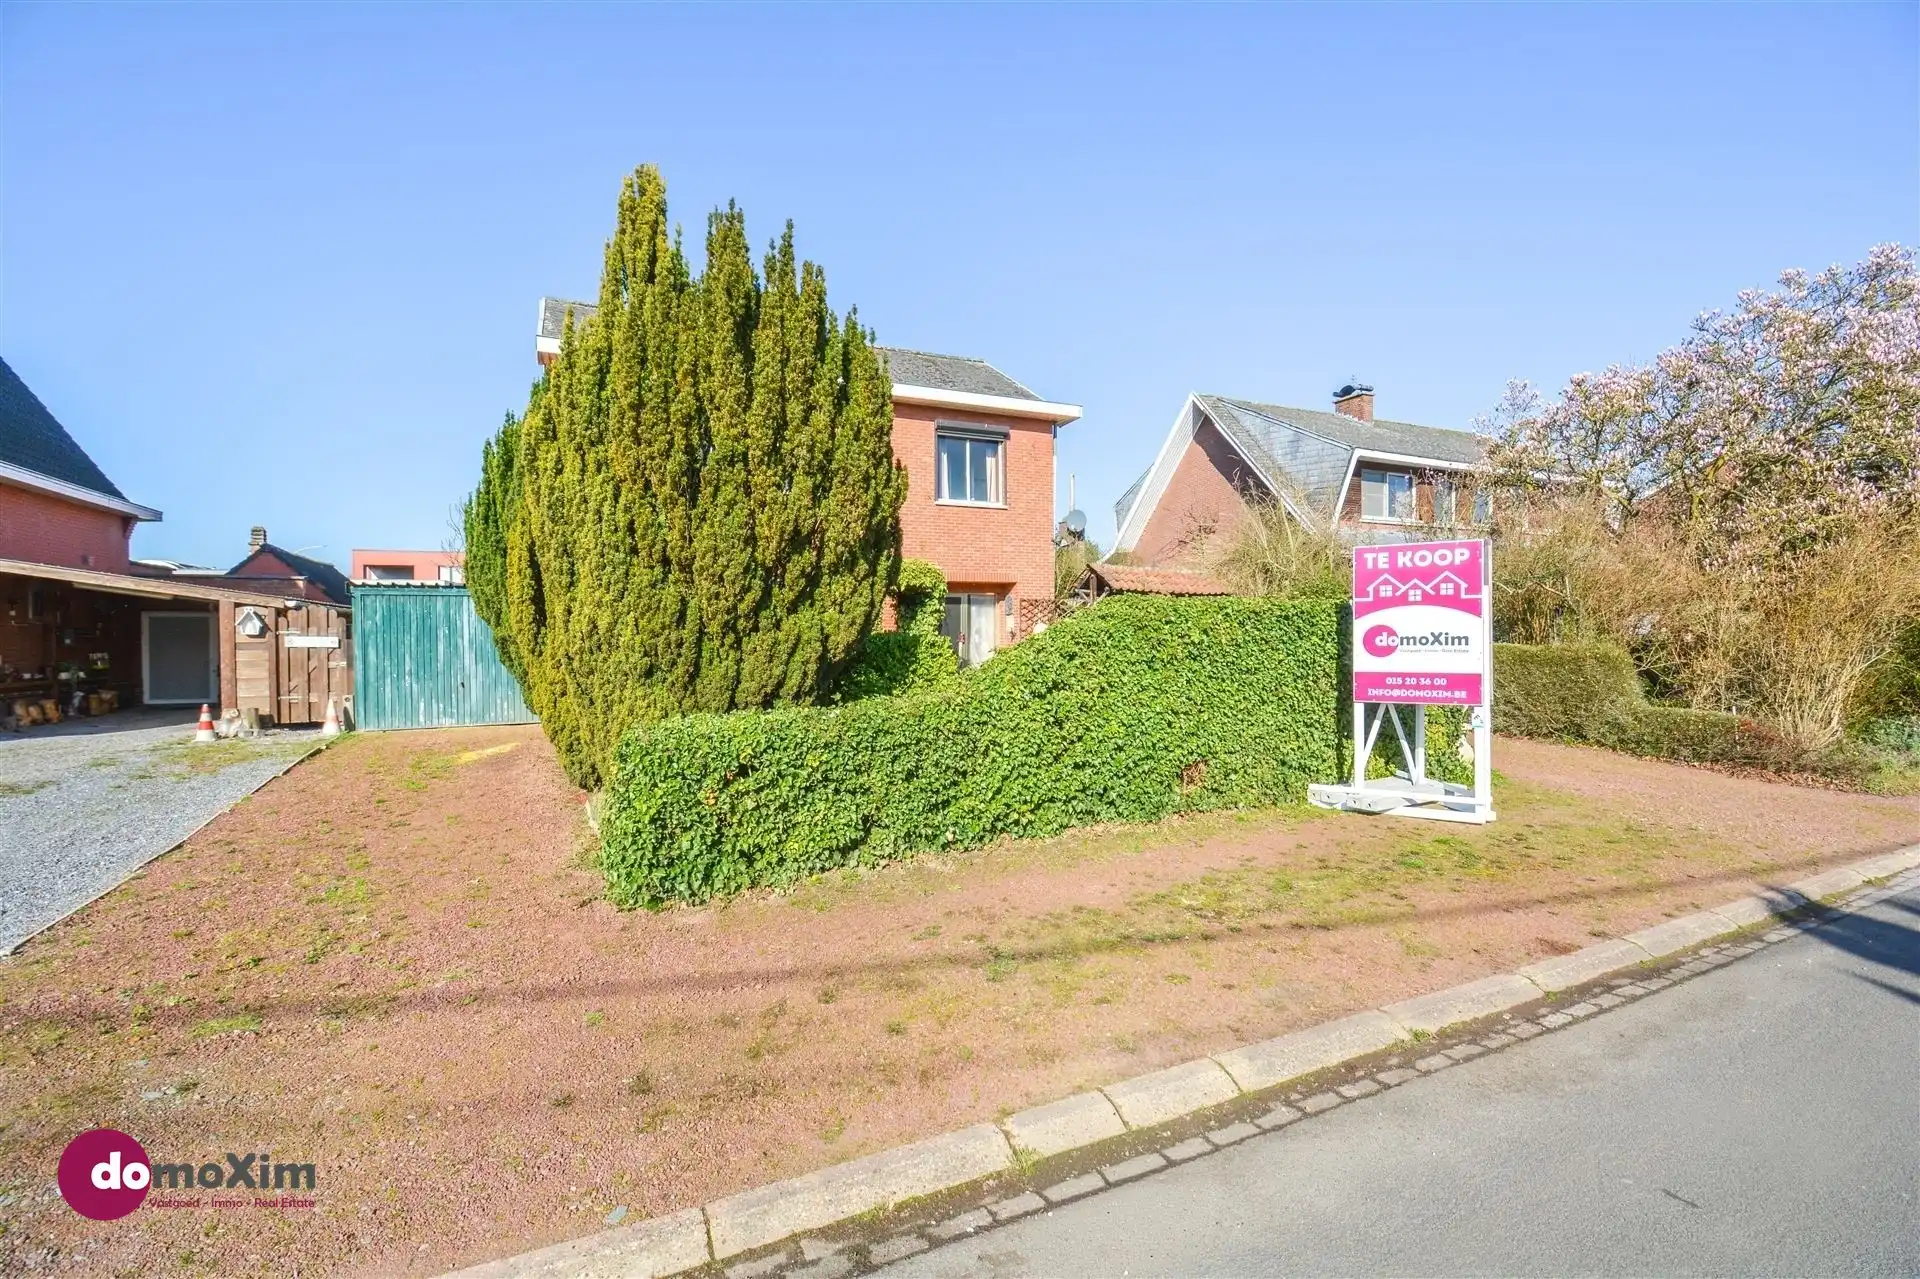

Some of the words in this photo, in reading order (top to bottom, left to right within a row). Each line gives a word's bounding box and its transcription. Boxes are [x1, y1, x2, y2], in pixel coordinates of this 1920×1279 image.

[1363, 552, 1389, 569] TE
[1397, 548, 1470, 568] KOOP
[1375, 631, 1469, 646] domoXim
[1386, 677, 1403, 685] 015
[1404, 677, 1417, 685] 20
[1419, 678, 1432, 686] 36
[1434, 678, 1447, 686] 00
[1367, 688, 1467, 698] INFO@DOMOXIM.BE
